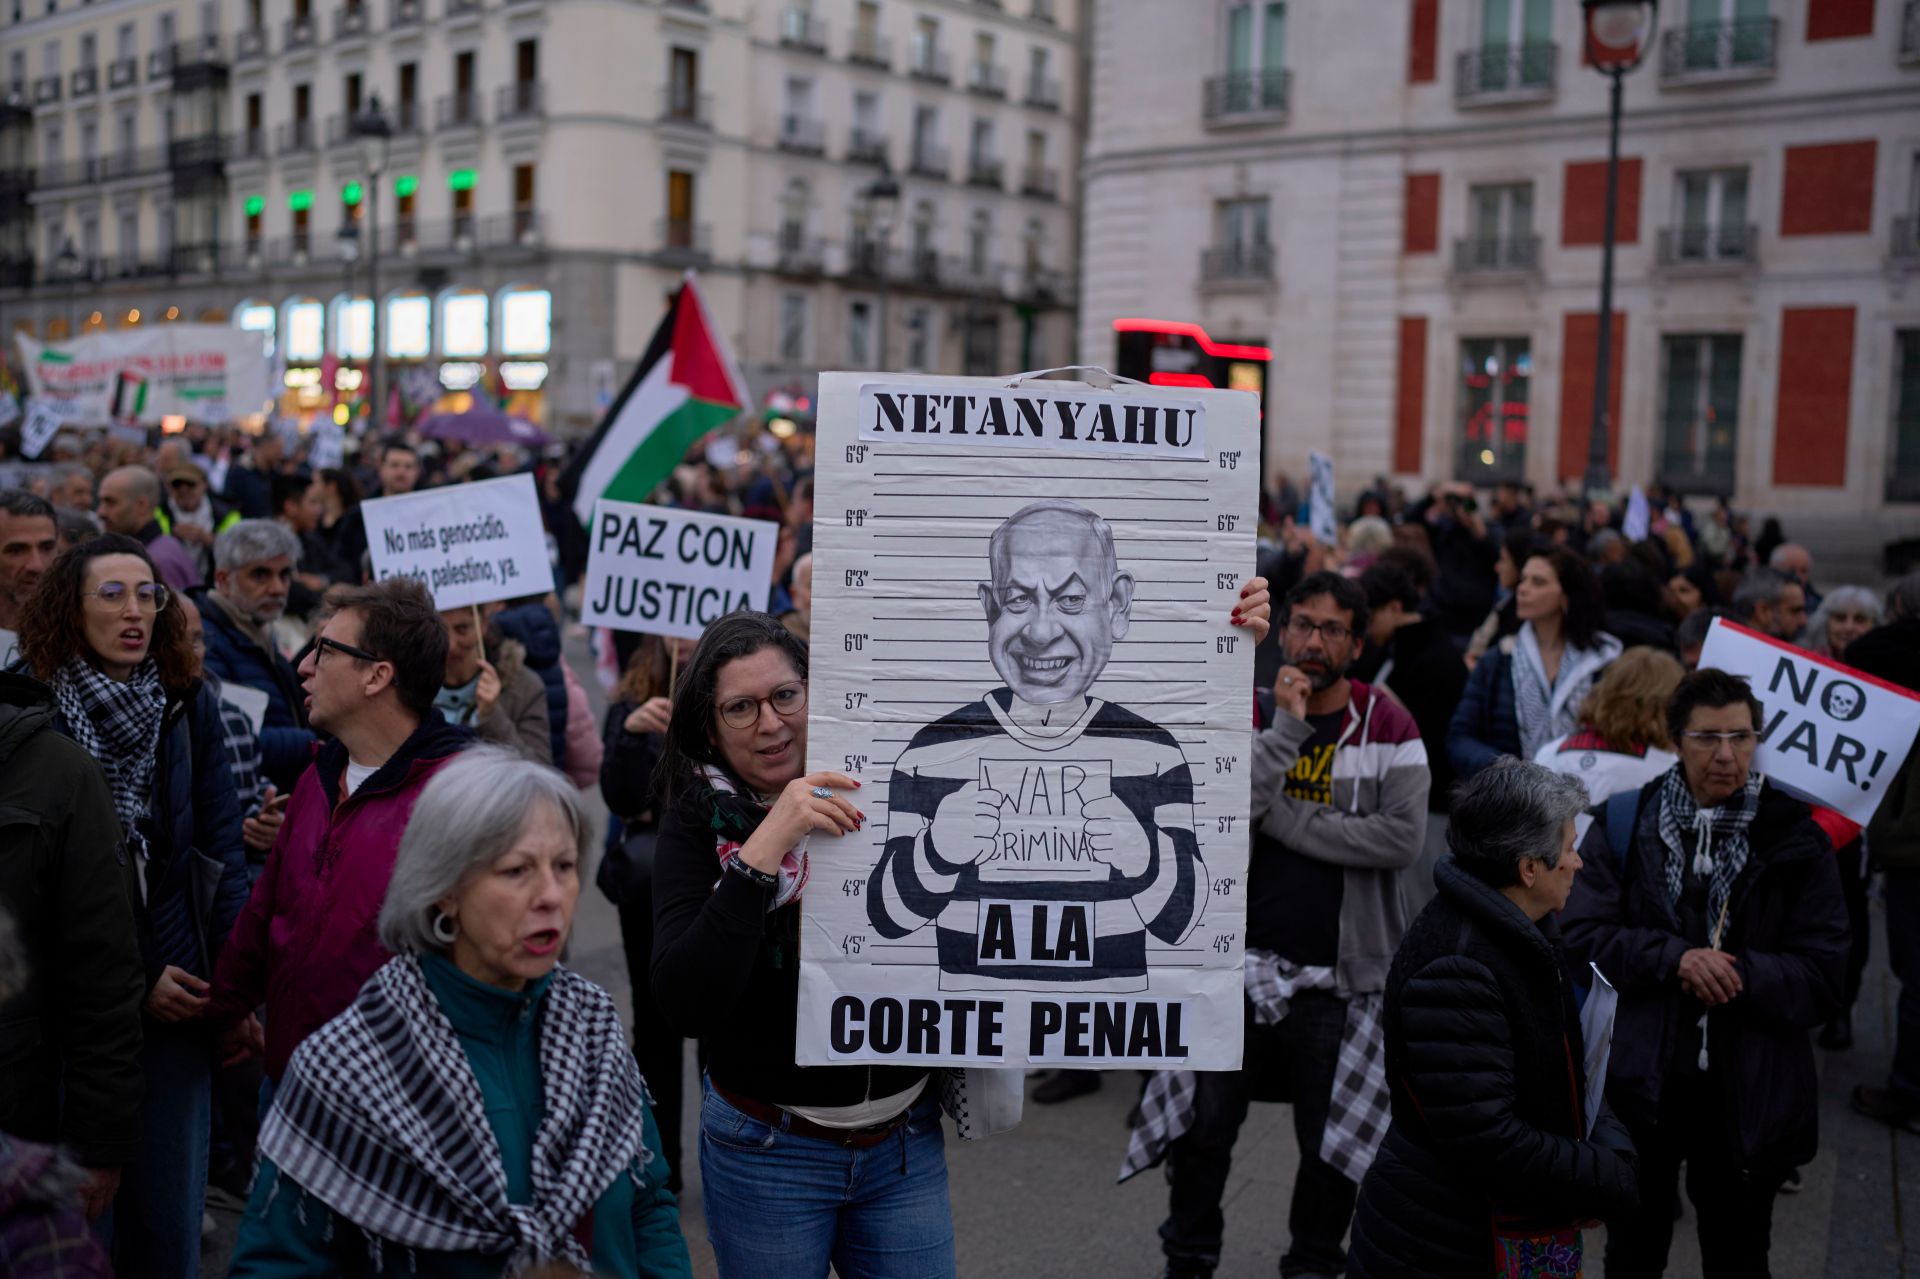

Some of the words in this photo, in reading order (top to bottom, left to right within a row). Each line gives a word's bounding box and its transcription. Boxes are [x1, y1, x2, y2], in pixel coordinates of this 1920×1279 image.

[873, 393, 1197, 447] NETANYAHU
[384, 526, 405, 556] No
[408, 521, 436, 550] más
[439, 514, 509, 553] genocidio.
[599, 513, 668, 560] PAZ
[677, 523, 755, 571] CON
[432, 556, 497, 594] palestino,
[499, 557, 520, 586] ya.
[1768, 655, 1867, 722] NO
[1760, 709, 1888, 792] AR!
[983, 765, 1086, 816] WAR
[979, 903, 1016, 960] A
[1030, 904, 1091, 961] LA
[830, 995, 1004, 1056] CORTE
[1028, 1001, 1189, 1057] PENAL
